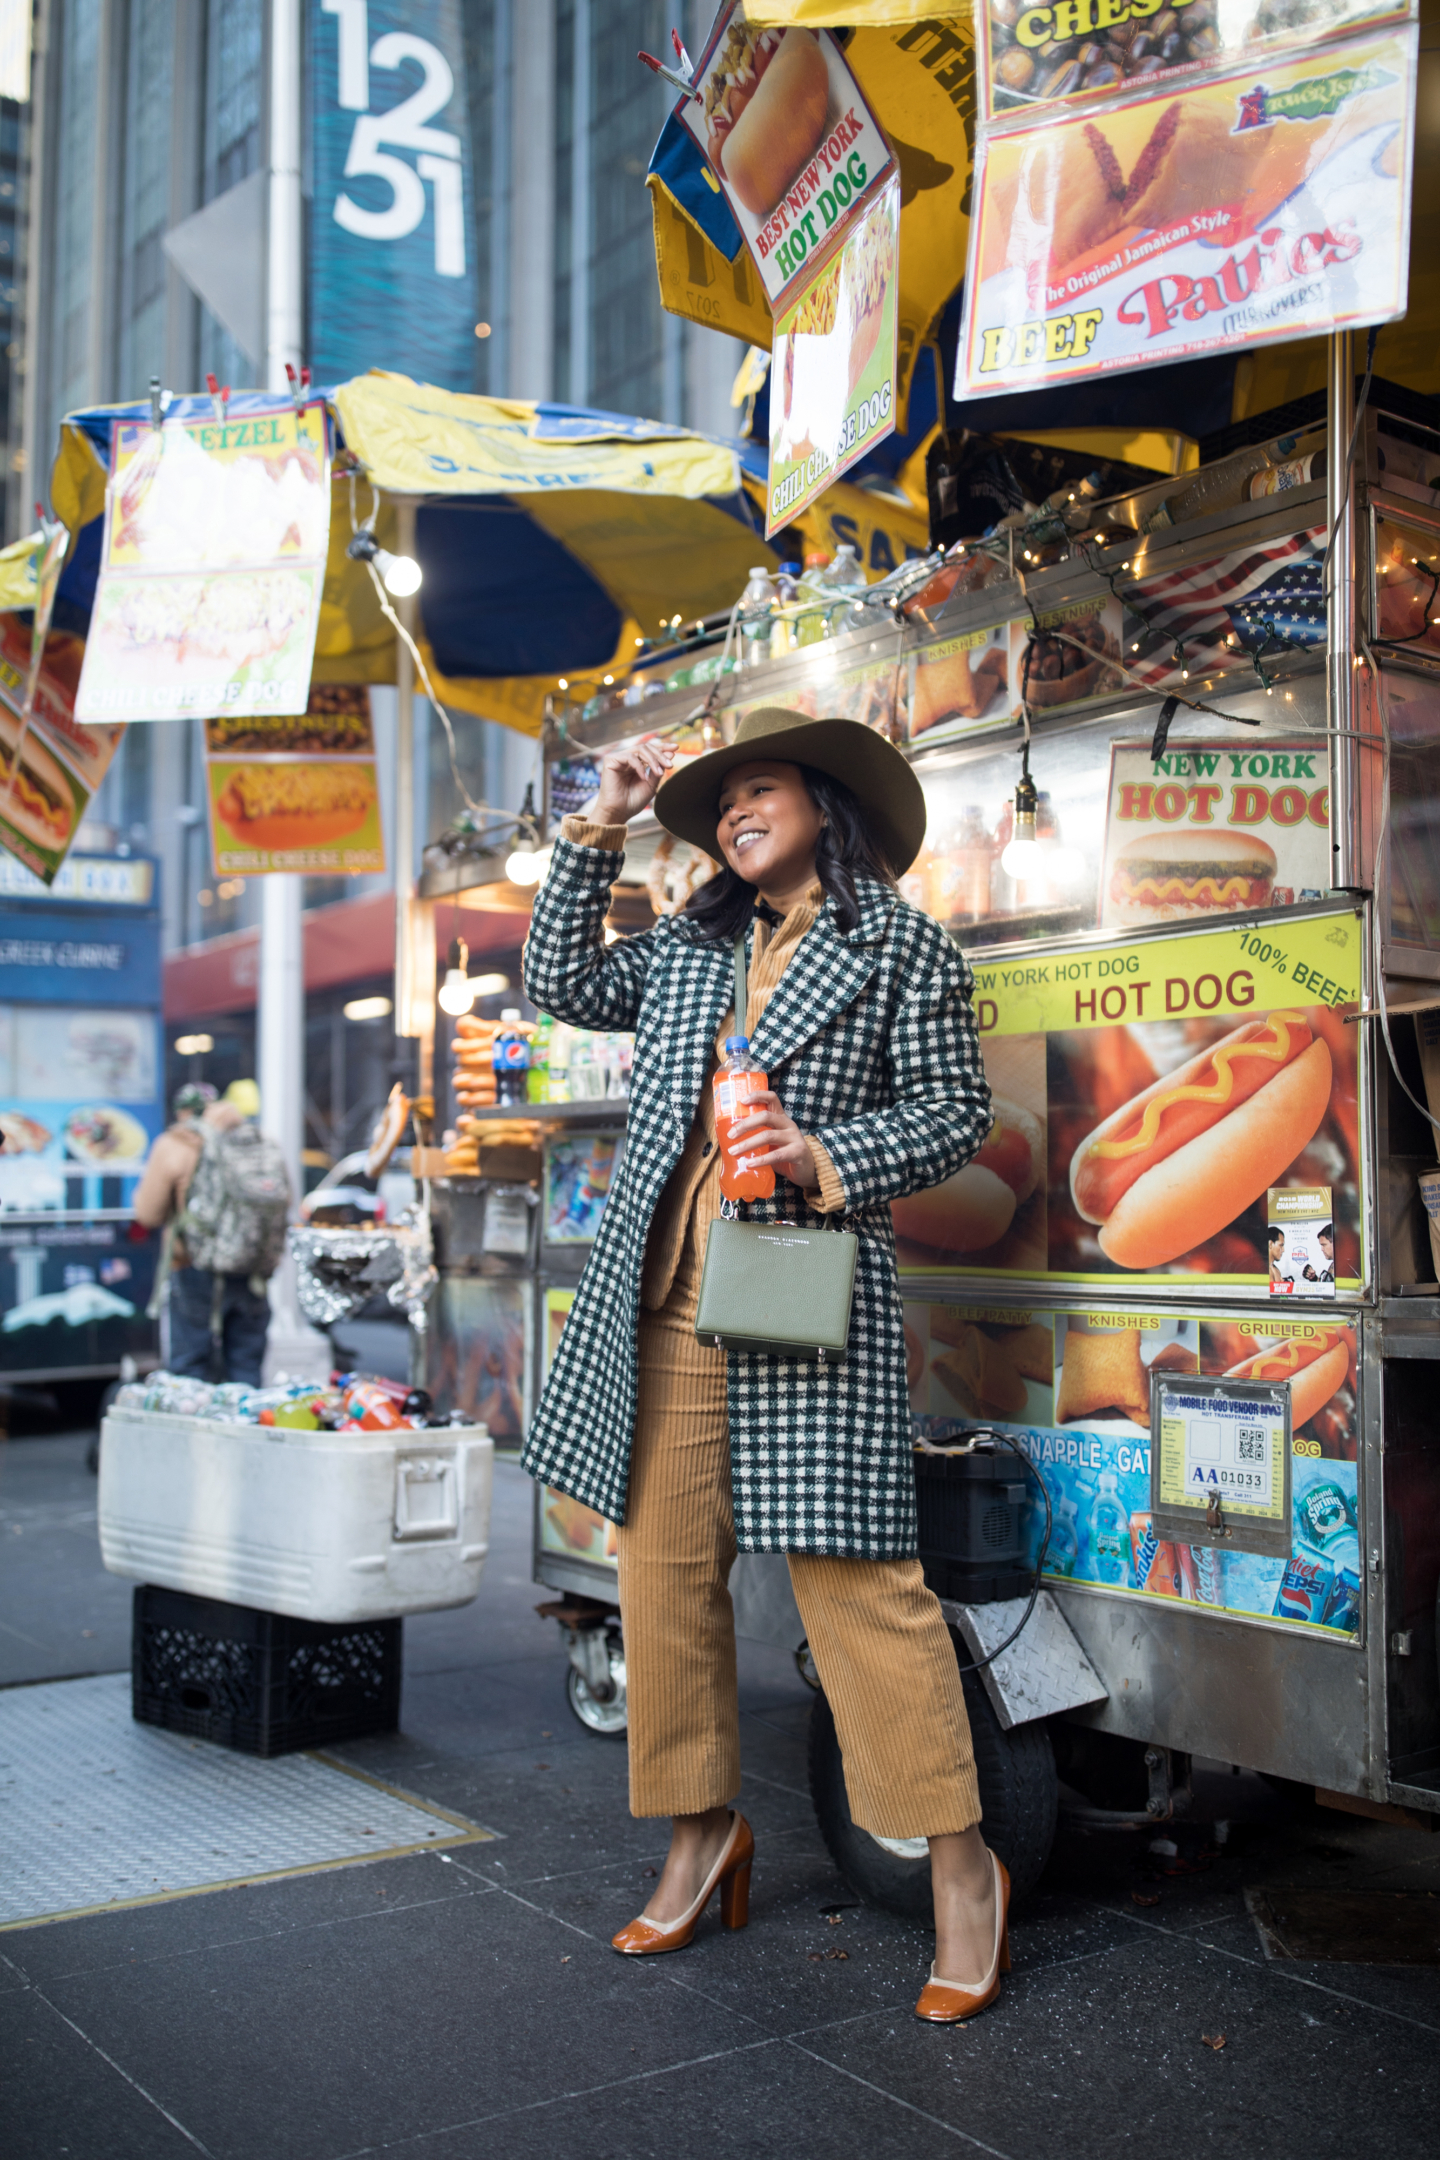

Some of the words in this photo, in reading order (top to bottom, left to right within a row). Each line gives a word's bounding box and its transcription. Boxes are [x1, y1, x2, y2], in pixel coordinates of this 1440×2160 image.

[755, 201, 790, 260] BEST
[786, 160, 821, 218] NEW
[817, 107, 864, 174] YORK
[774, 210, 819, 281] HOT
[816, 150, 867, 230] DOG
[1067, 258, 1124, 293] Original
[1124, 226, 1190, 265] Jamaican
[1191, 209, 1231, 237] Style
[978, 307, 1104, 374] BEEF
[1101, 355, 1139, 370] ASTORIA
[1142, 344, 1185, 360] PRINTING
[771, 461, 806, 517] CHILI
[857, 379, 892, 440] DOG
[928, 631, 987, 661] KNISHES
[1152, 754, 1221, 778] NEW
[1228, 754, 1317, 779] YORK
[1116, 781, 1224, 824] HOT
[1001, 966, 1050, 988] YORK
[1055, 961, 1092, 982] HOT
[1097, 955, 1140, 977] DOG
[1238, 932, 1289, 975] 100%
[1291, 961, 1351, 1006] BEEF
[1074, 981, 1151, 1023] HOT
[1165, 969, 1255, 1014] DOG
[1276, 1201, 1324, 1210] CHAMPIONSHIP
[1297, 1194, 1321, 1203] WORLD
[1088, 1313, 1160, 1331] KNISHES
[1239, 1322, 1316, 1338] GRILLED
[1179, 1396, 1207, 1411] MOBILE
[1208, 1398, 1228, 1412] FOOD
[1229, 1400, 1259, 1416] VENDOR
[1214, 1412, 1256, 1422] TRANSFERABLE
[1019, 1433, 1102, 1469] SNAPPLE
[1192, 1466, 1219, 1484] AA
[1221, 1471, 1262, 1487] 01033
[1307, 1495, 1345, 1525] Spring
[1096, 1538, 1122, 1552] Spring
[1287, 1553, 1324, 1580] diet
